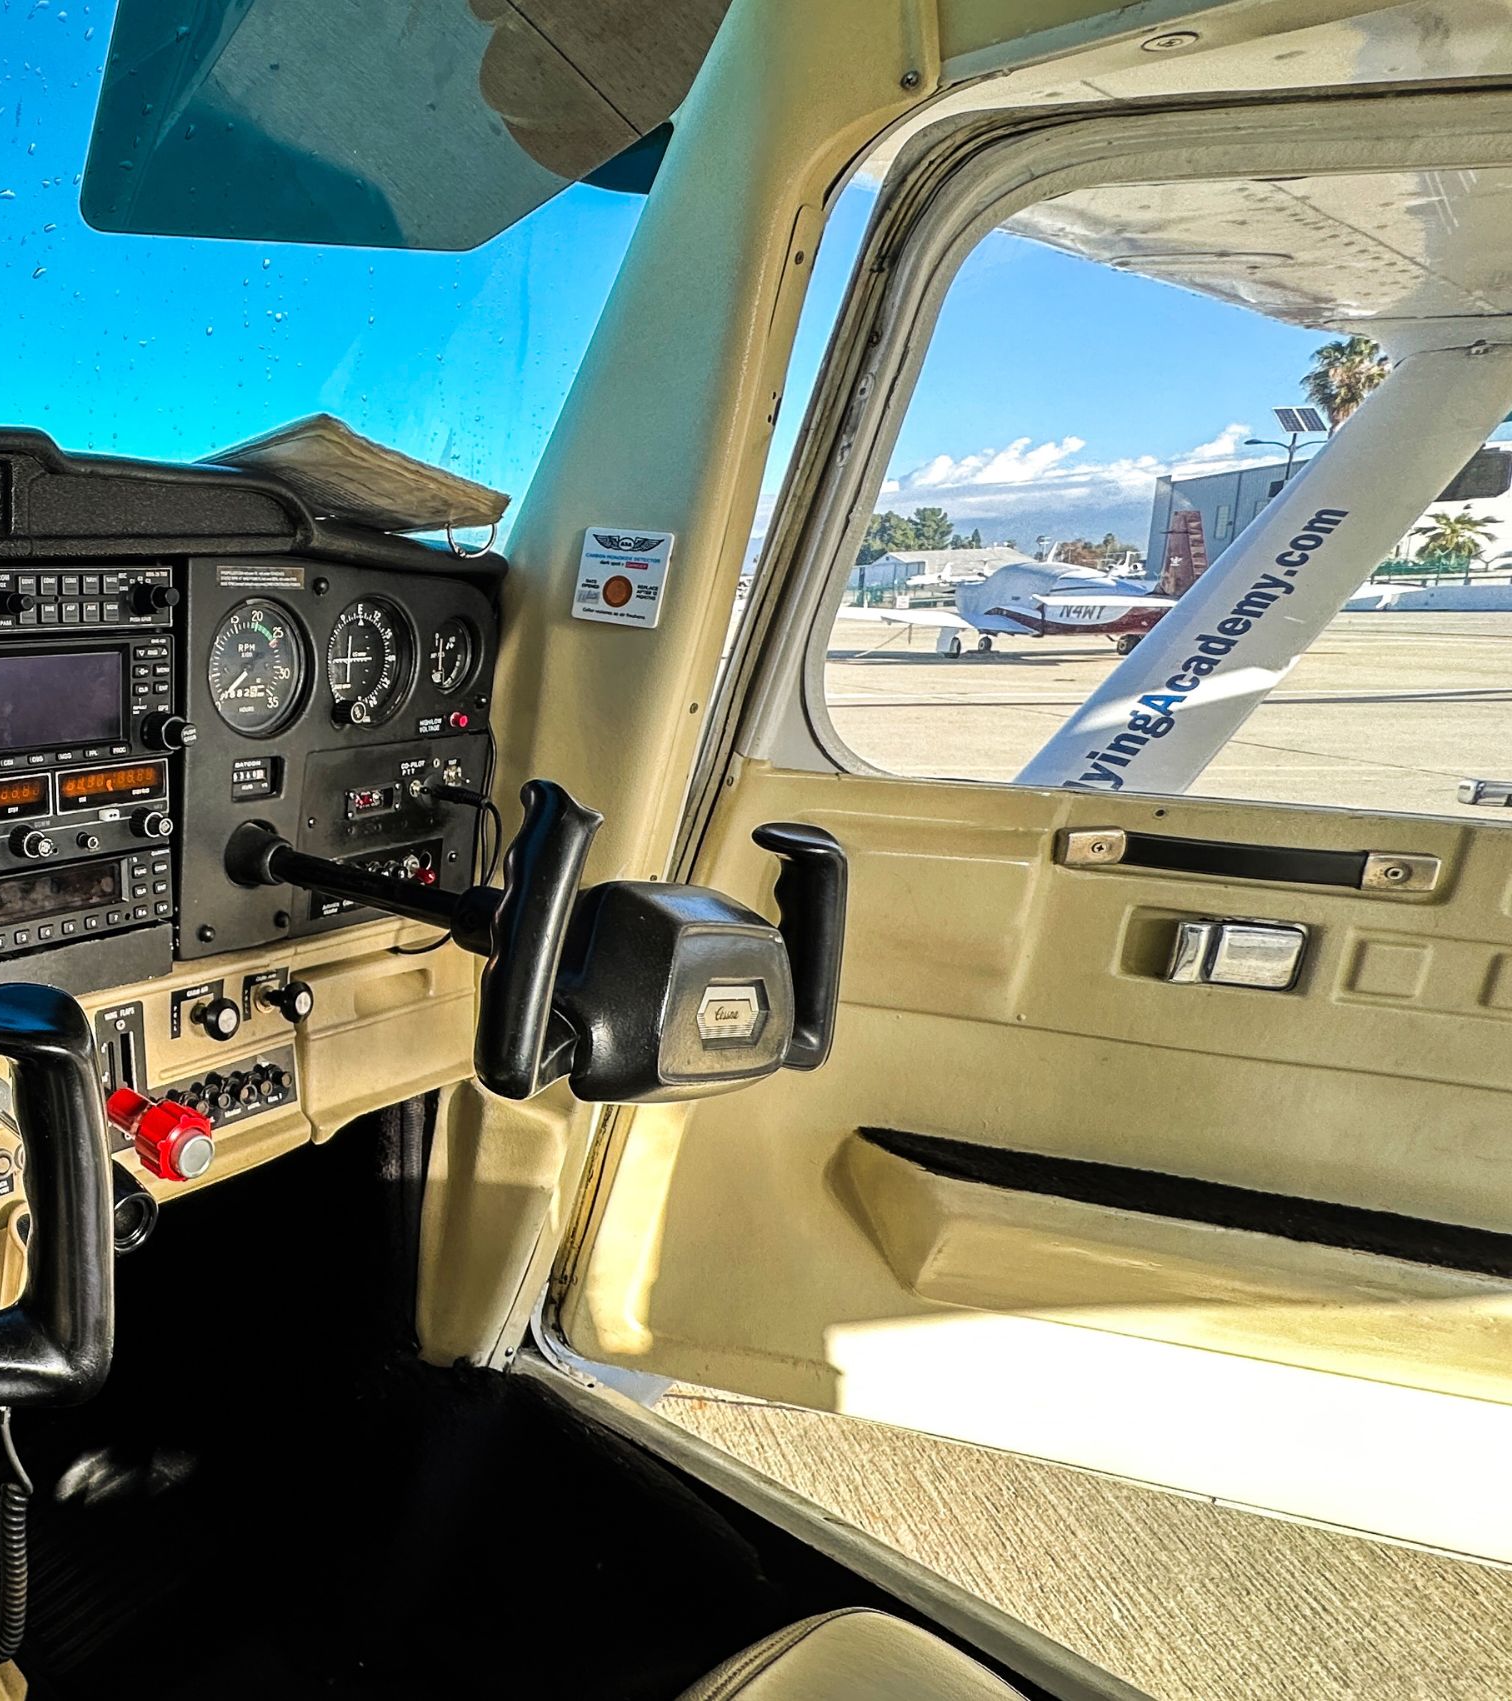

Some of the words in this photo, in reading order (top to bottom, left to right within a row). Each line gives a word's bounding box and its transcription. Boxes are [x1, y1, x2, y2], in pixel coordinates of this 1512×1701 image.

[251, 610, 263, 621] 20
[238, 643, 255, 652] RPM
[278, 668, 290, 679] 30
[267, 697, 279, 708] 35
[120, 1007, 135, 1018] FLAPS
